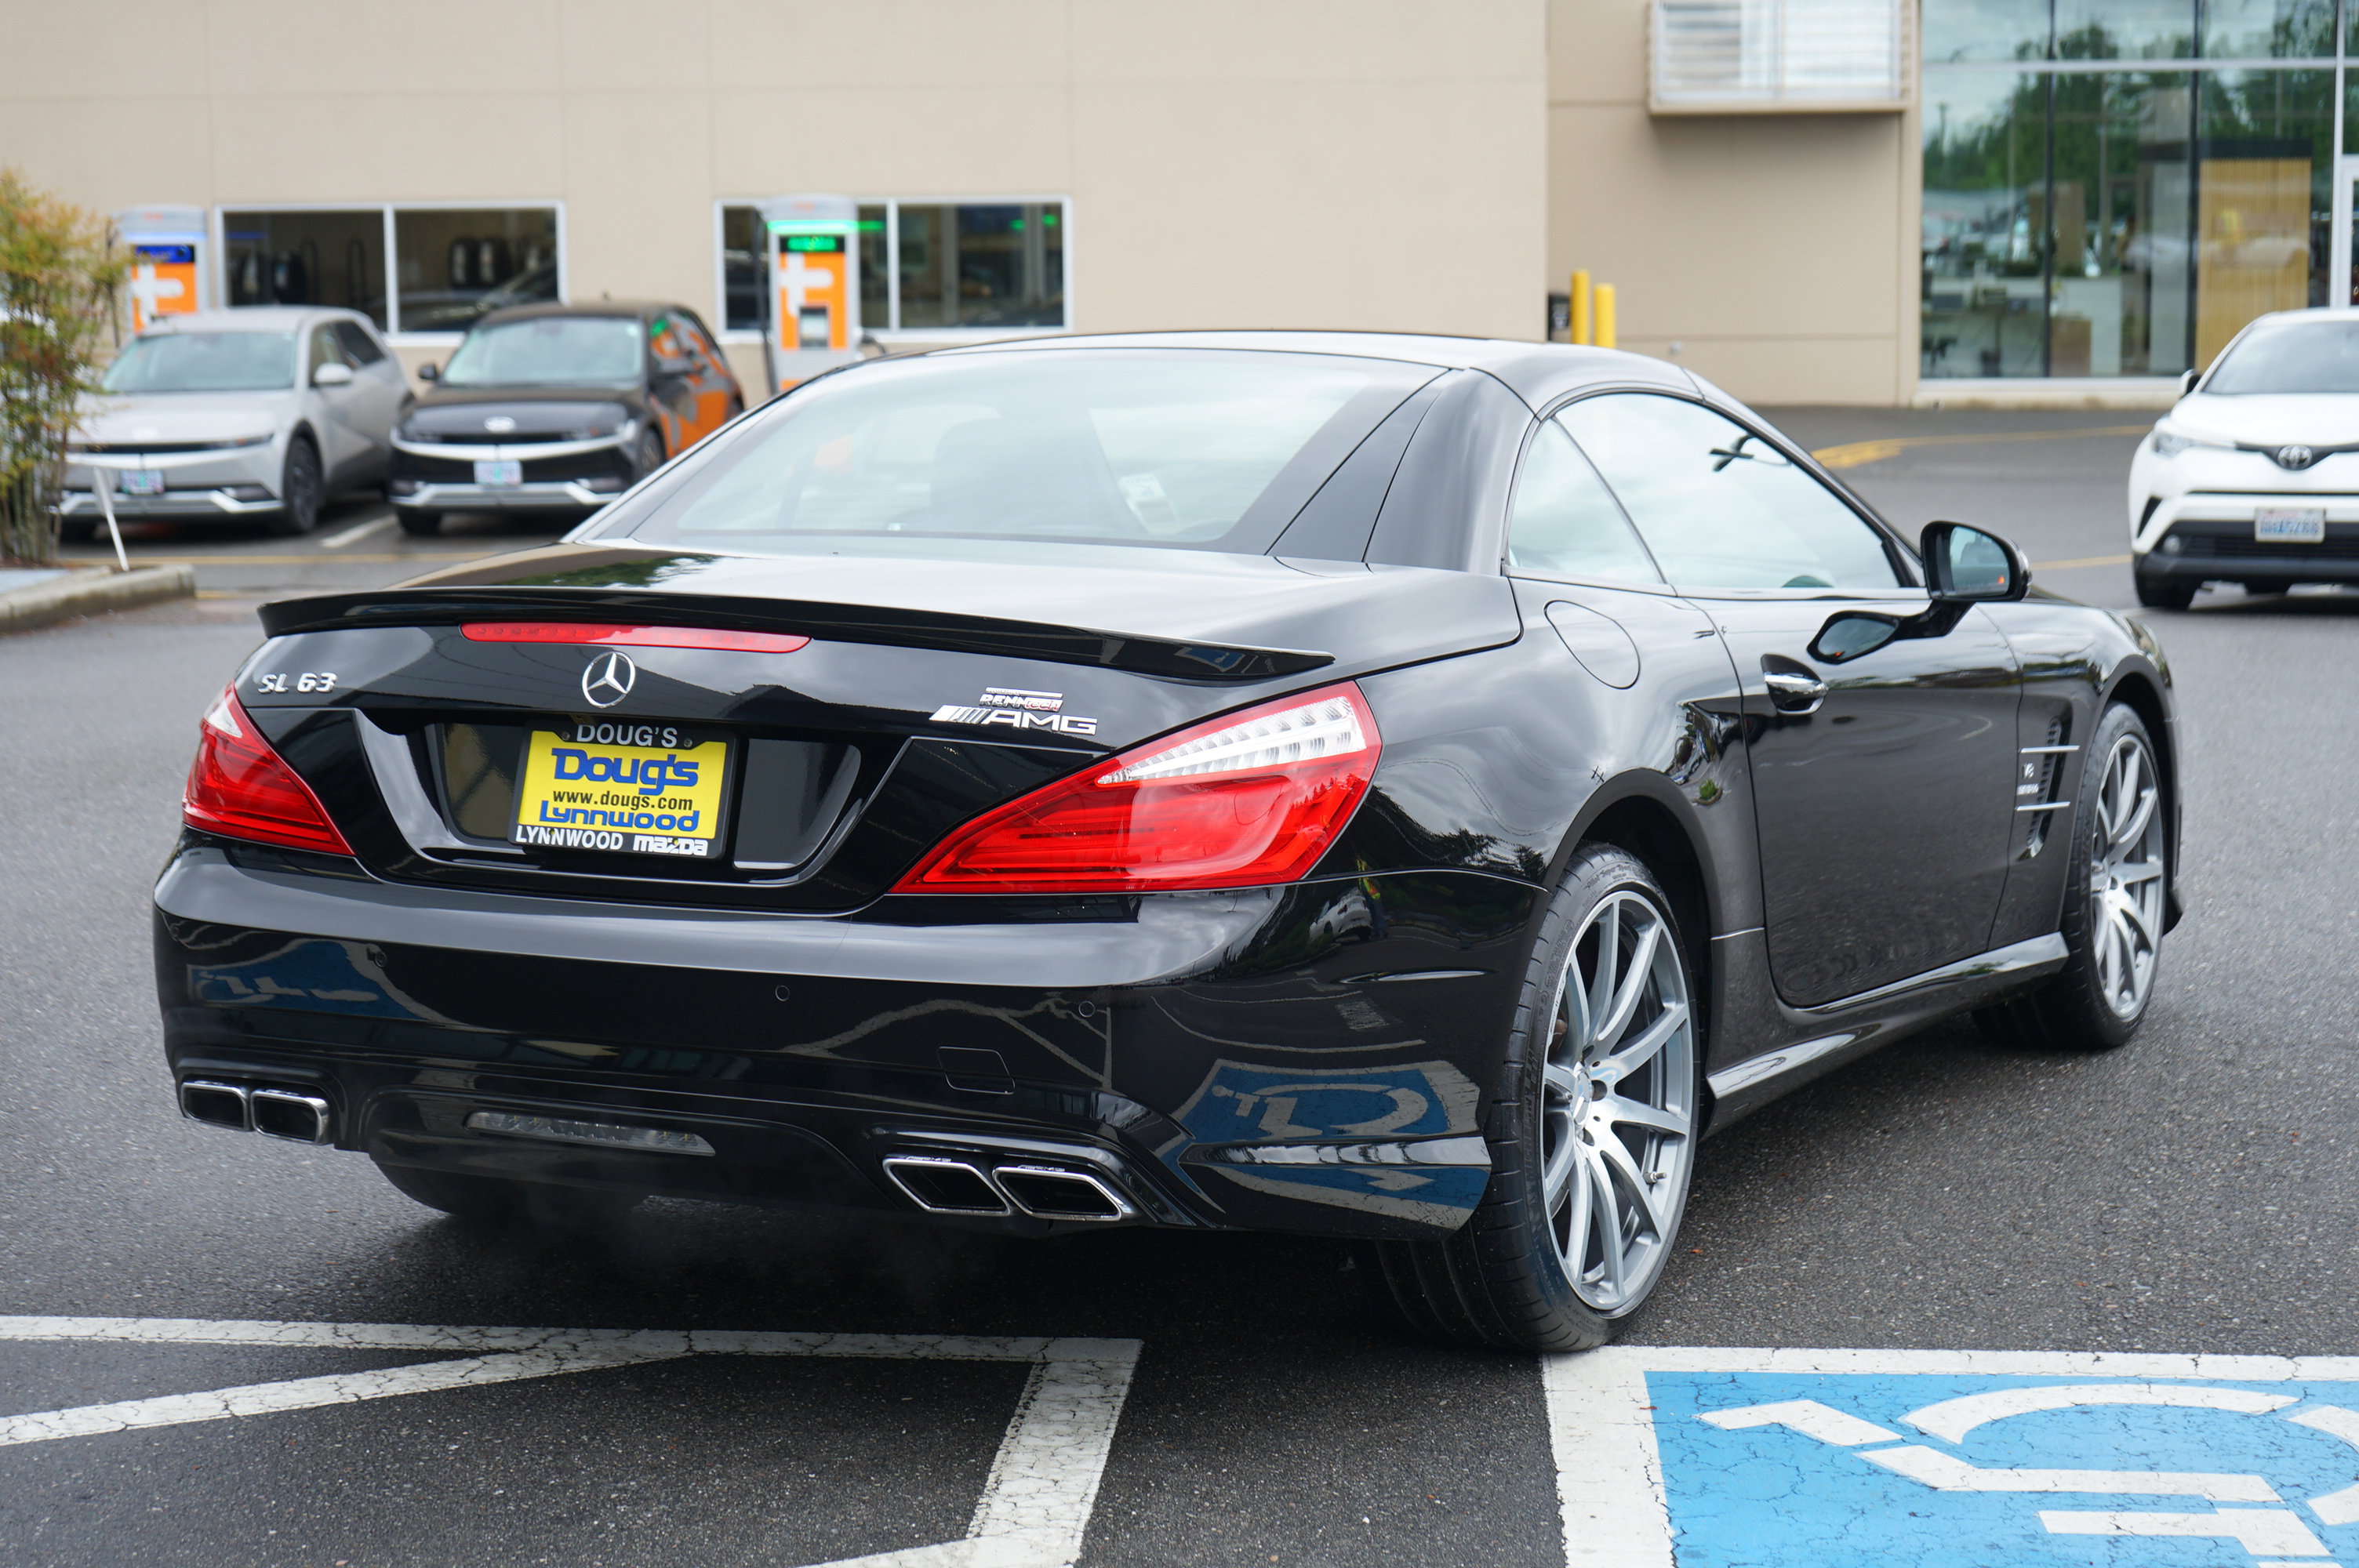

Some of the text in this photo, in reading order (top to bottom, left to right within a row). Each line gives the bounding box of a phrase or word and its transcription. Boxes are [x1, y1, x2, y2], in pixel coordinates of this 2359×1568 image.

[258, 673, 337, 694] SL 63
[576, 724, 678, 748] DOUG'S
[551, 748, 699, 796] Doug's
[553, 790, 692, 811] www.dougs.com
[540, 800, 700, 832] Lynnwood
[515, 825, 623, 850] LYNNWOOD
